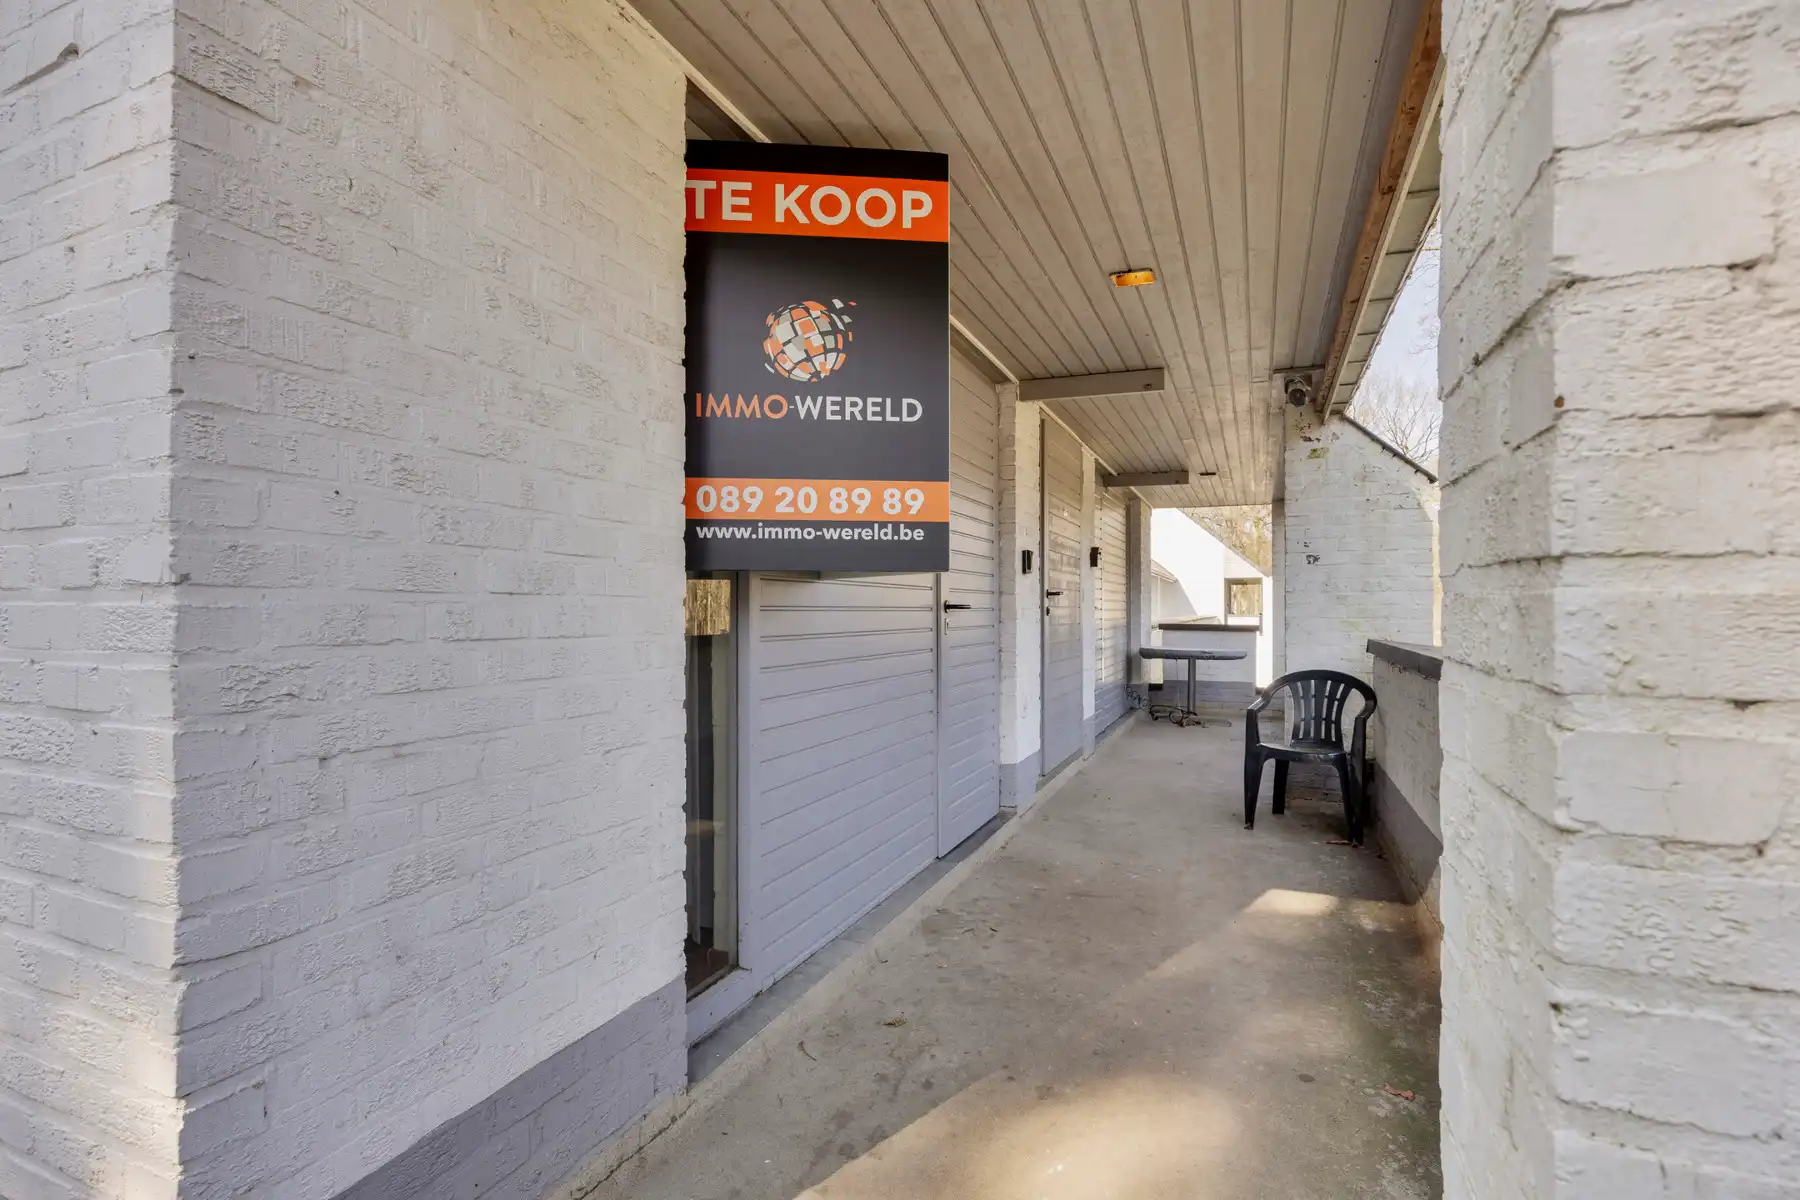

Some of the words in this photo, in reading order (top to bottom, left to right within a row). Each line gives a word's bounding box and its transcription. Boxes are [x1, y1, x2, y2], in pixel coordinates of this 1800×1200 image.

[685, 179, 753, 222] TE
[774, 184, 933, 229] KOOP
[695, 393, 923, 423] IMMO-WERELD
[696, 485, 764, 513] 089
[775, 486, 818, 514] 20
[829, 487, 872, 515] 89
[882, 488, 925, 515] 89
[696, 522, 925, 541] www.immo-wereld.be
